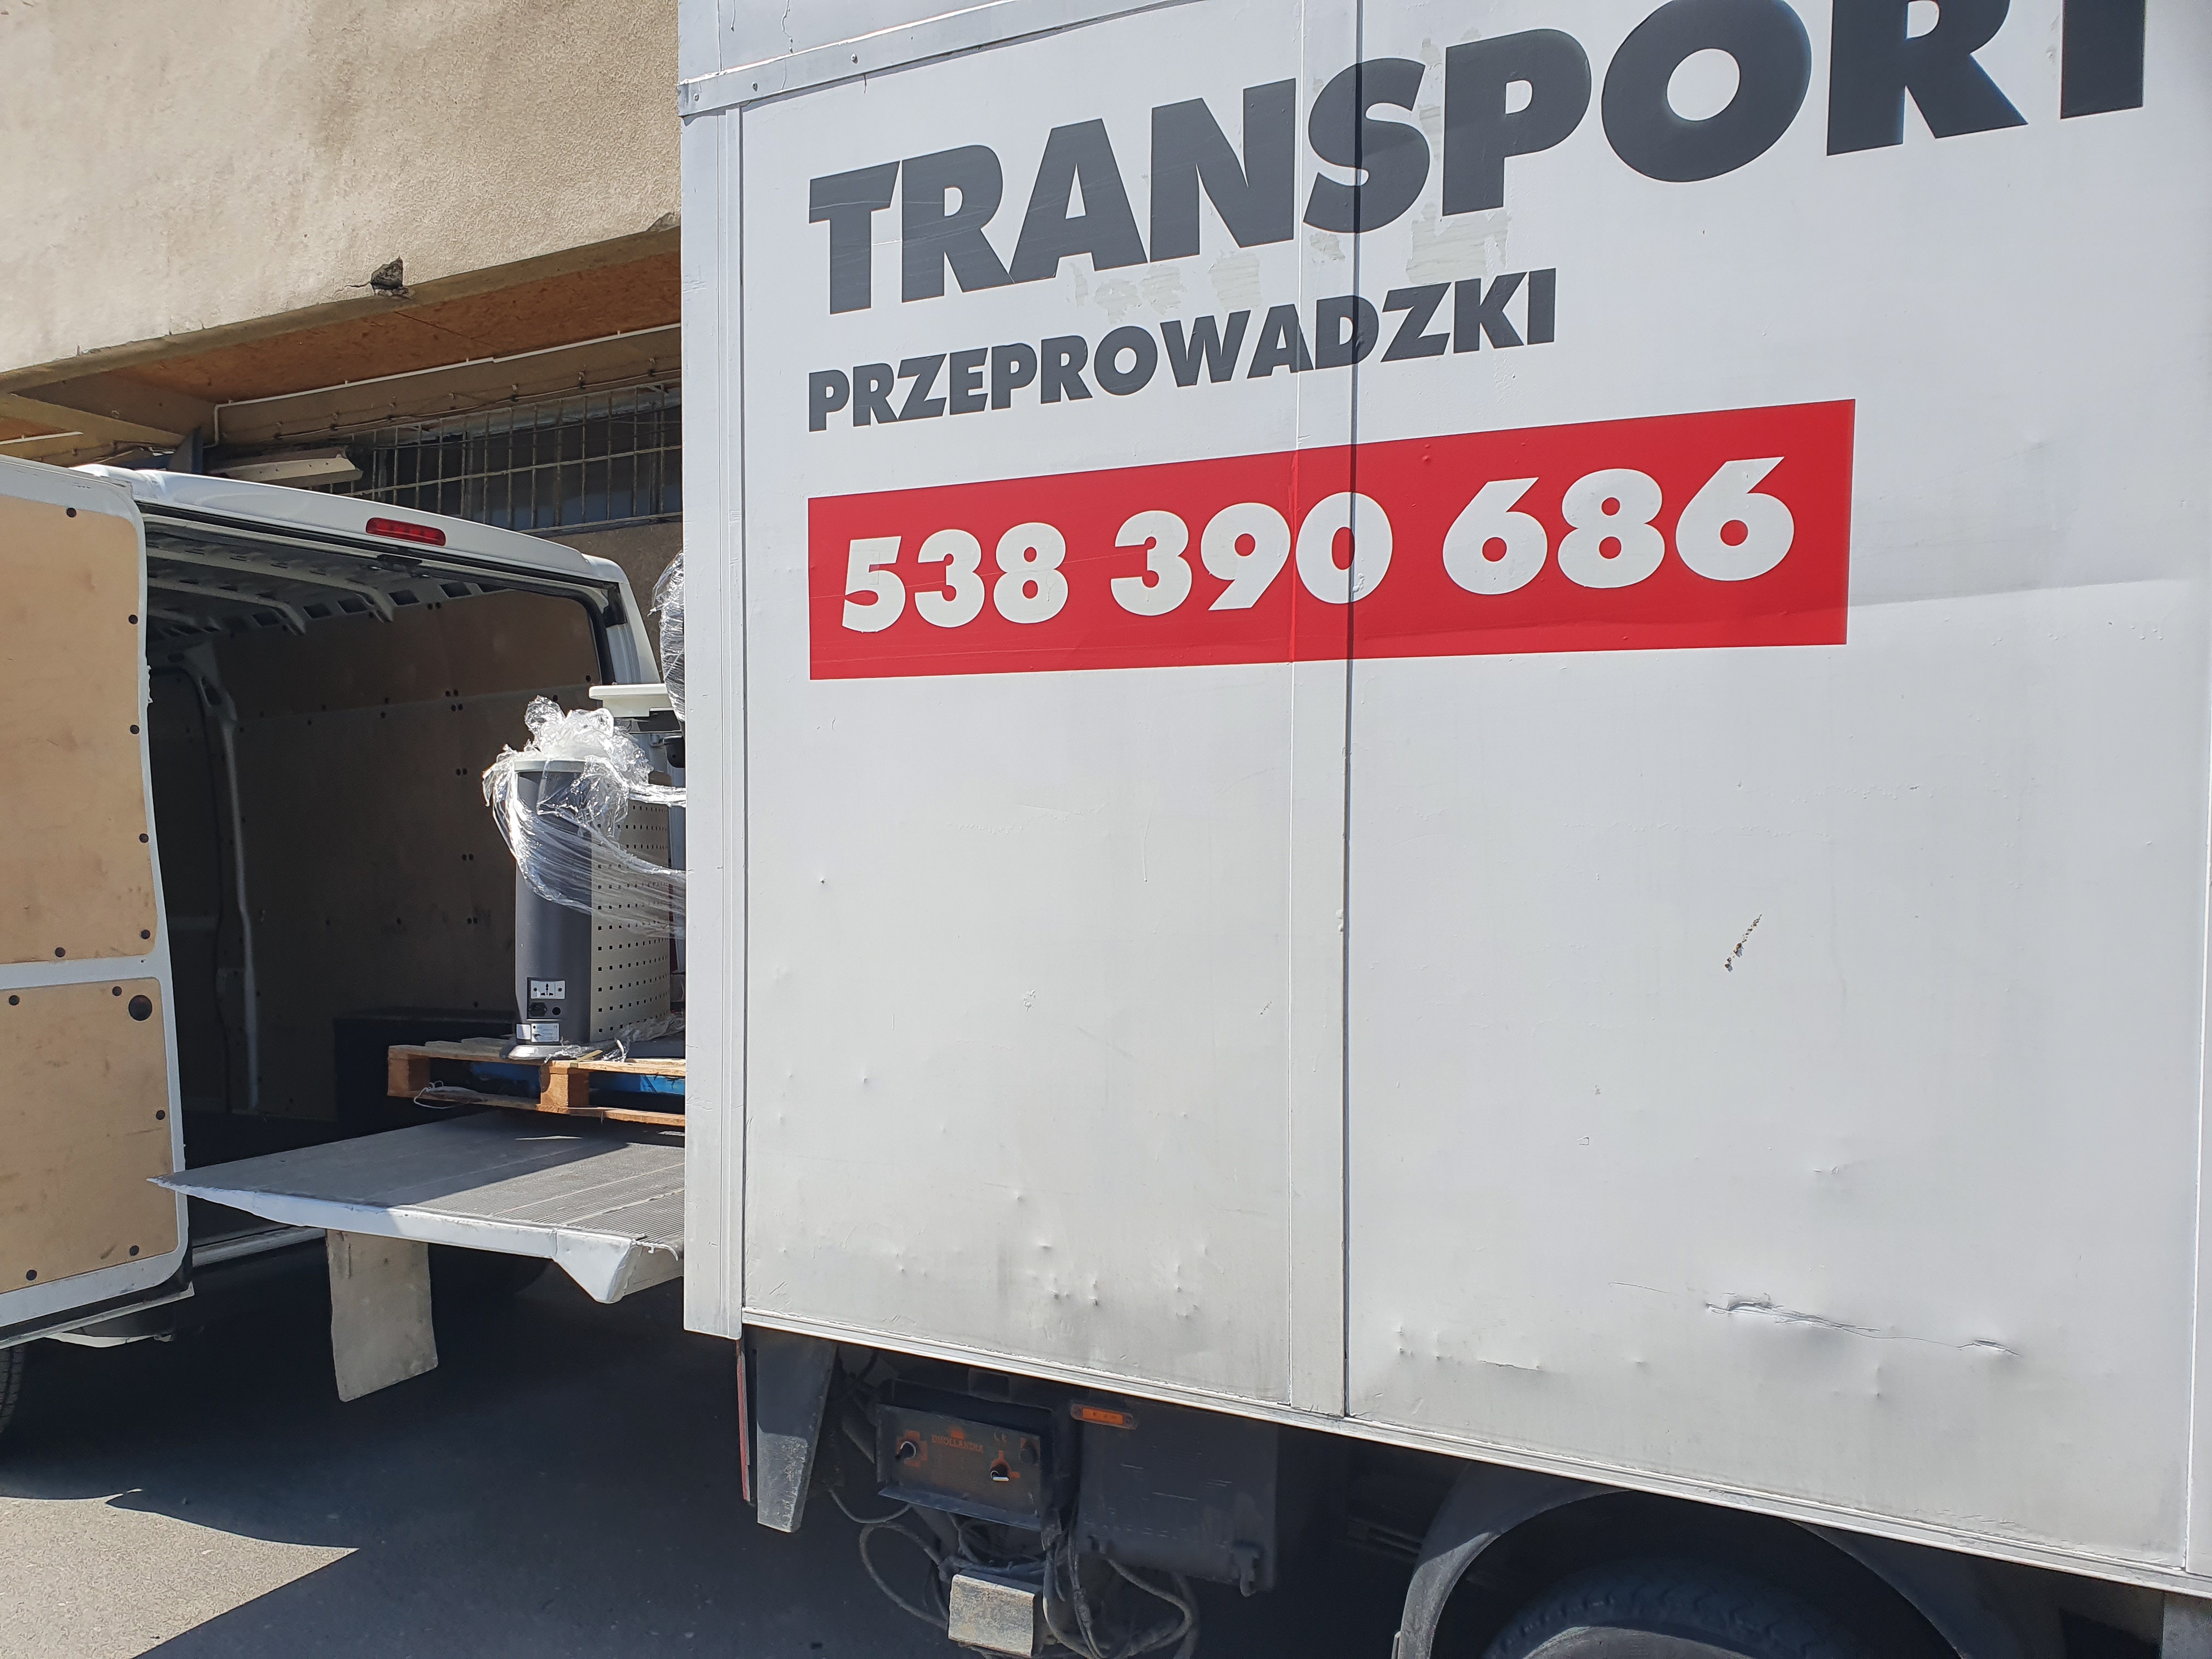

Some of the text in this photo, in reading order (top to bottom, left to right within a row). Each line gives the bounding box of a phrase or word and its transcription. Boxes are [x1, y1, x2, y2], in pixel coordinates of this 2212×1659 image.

[809, 267, 1556, 432] PRZEPROWADZKI
[842, 456, 1795, 633] 538 390 686
